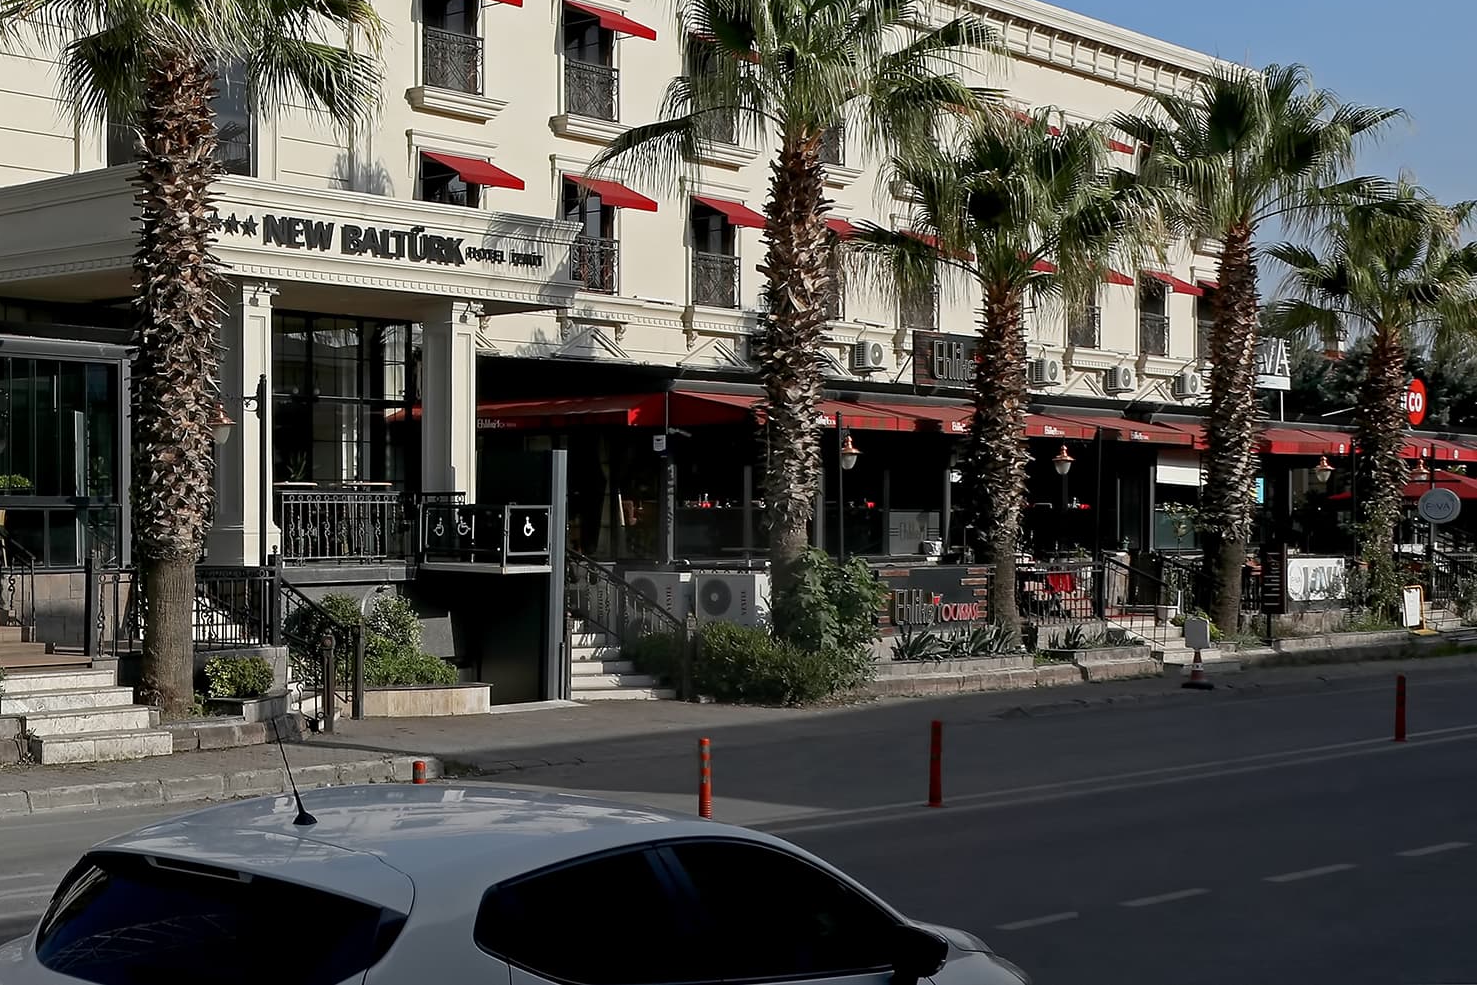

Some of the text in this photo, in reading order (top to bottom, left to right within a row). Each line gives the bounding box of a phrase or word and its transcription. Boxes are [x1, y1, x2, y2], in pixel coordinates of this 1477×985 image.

[263, 214, 335, 252] NEW
[340, 224, 466, 267] BALTÜRK
[466, 246, 506, 264] HOTEL
